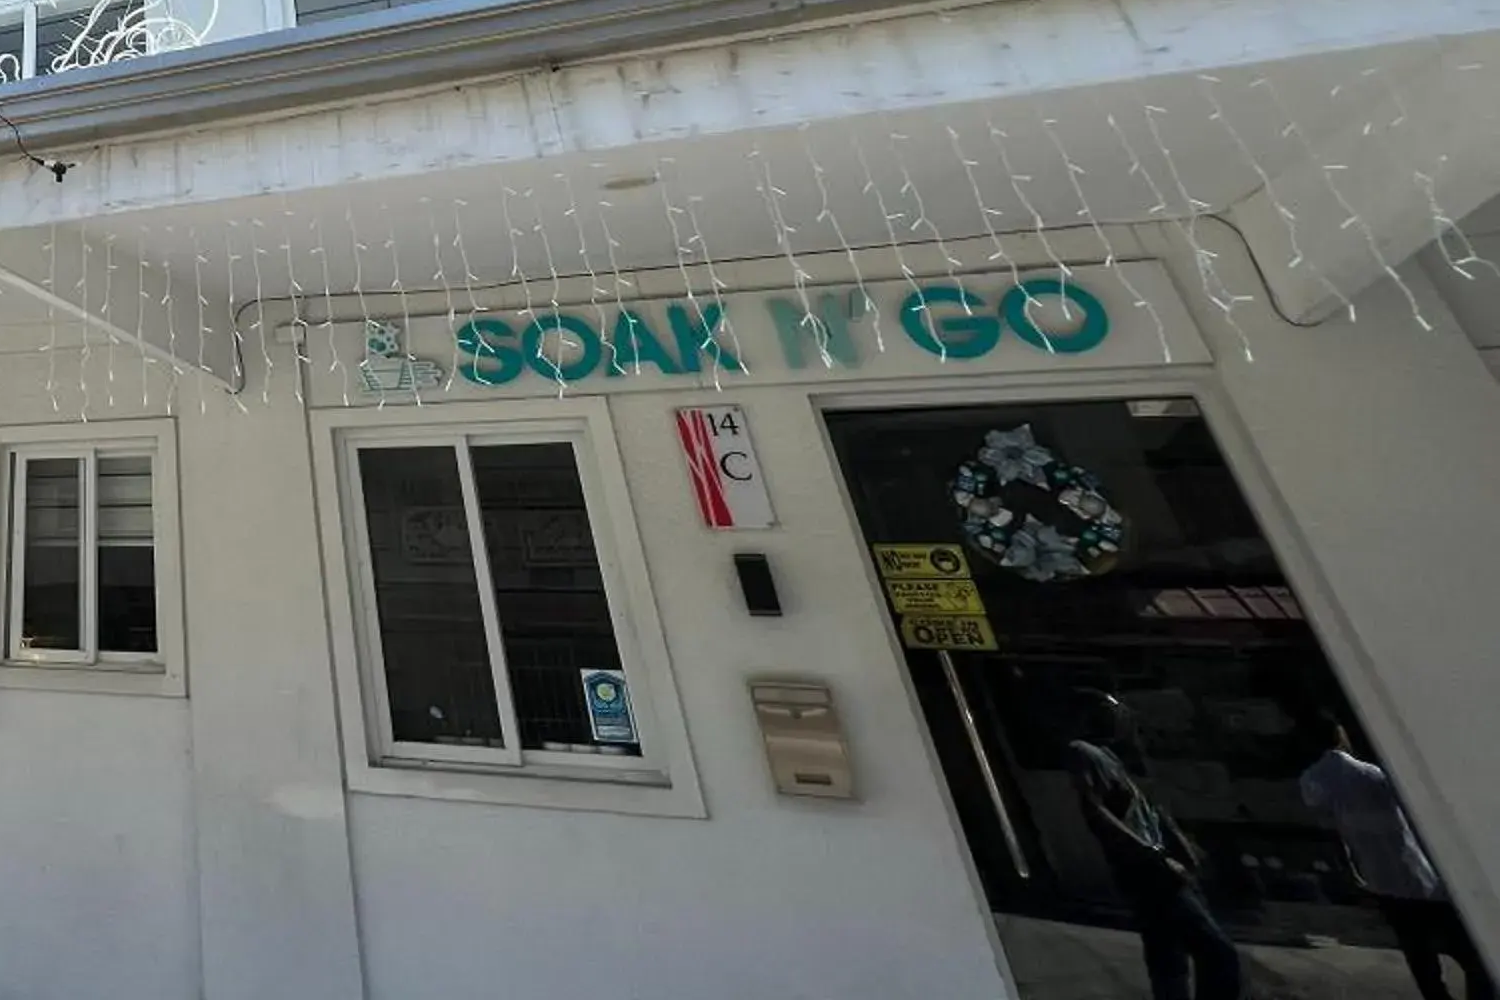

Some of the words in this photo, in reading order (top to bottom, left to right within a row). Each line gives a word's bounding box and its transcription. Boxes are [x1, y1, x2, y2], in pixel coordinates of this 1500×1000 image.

[457, 301, 749, 386] SOAK
[900, 278, 1109, 359] GO
[707, 413, 739, 436] 14
[720, 451, 753, 480] C
[912, 625, 985, 645] OPEN
